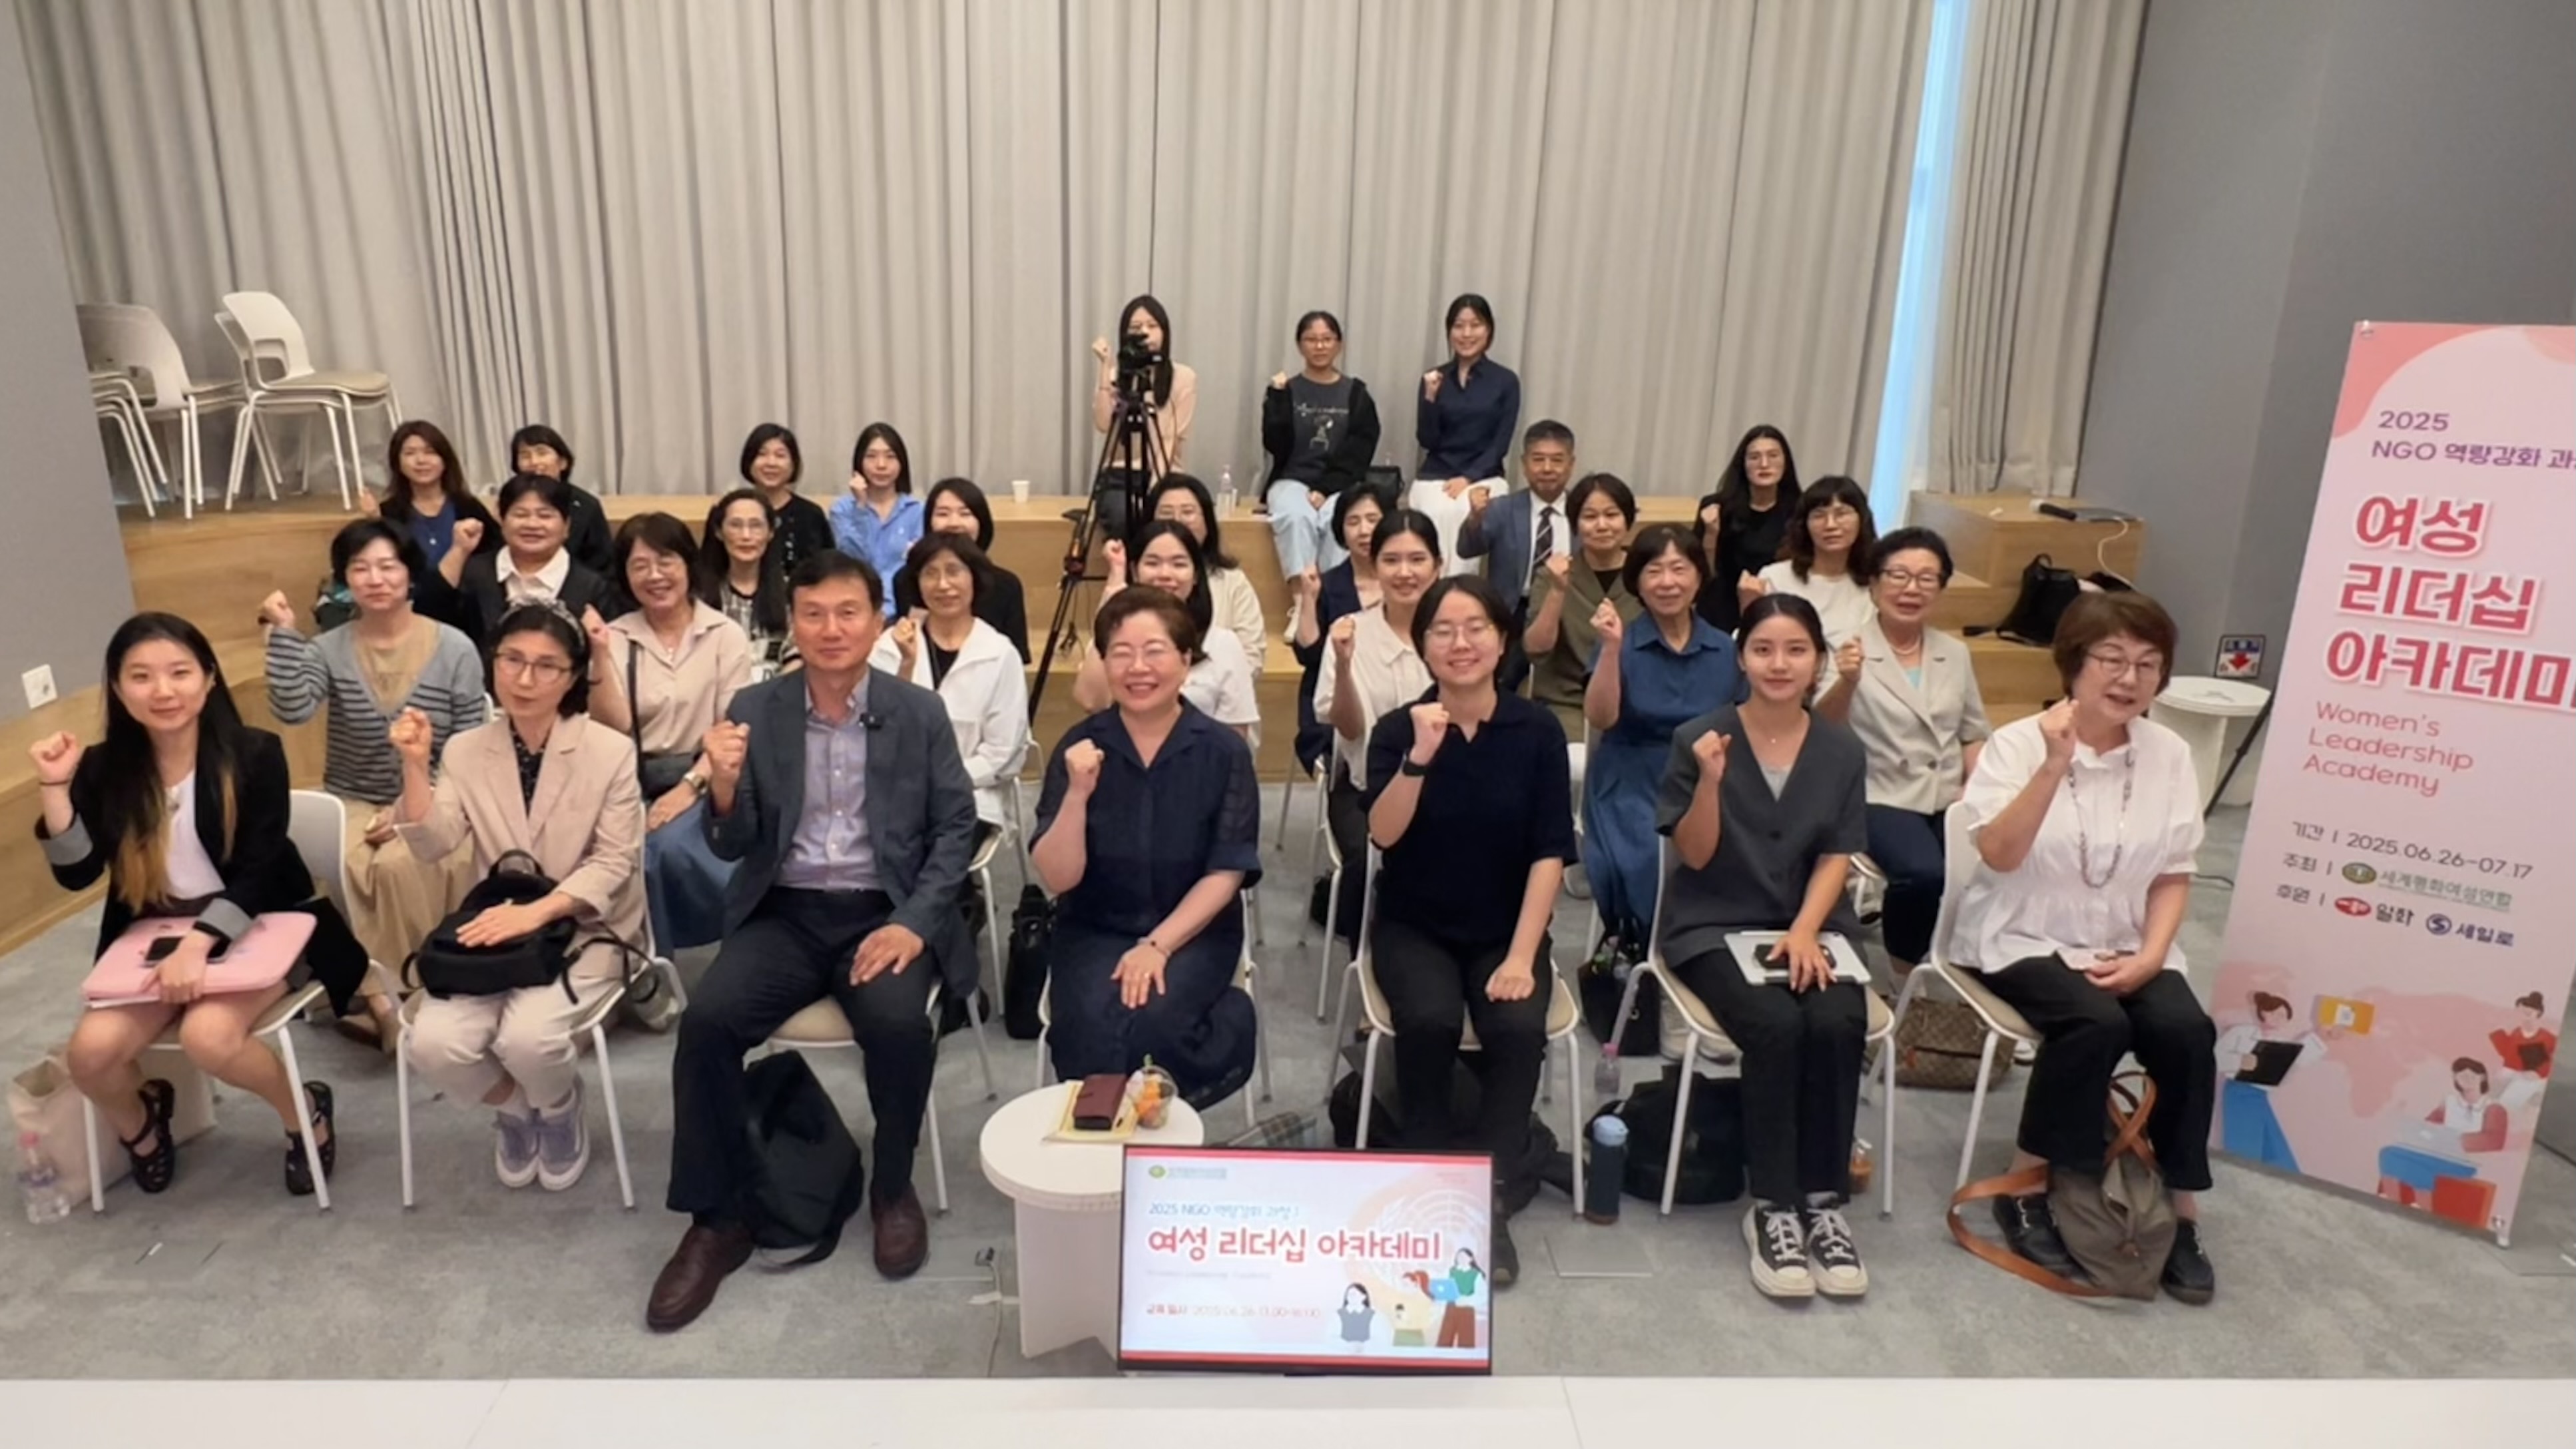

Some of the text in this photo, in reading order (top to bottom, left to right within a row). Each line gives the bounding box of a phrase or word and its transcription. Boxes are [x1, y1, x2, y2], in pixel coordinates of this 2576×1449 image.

[2378, 410, 2449, 432] 2025
[2372, 440, 2576, 469] NGO 역량강화 과
[2356, 496, 2484, 553] 여성
[2339, 563, 2535, 631] 리더십
[2316, 701, 2442, 737] Women's
[2308, 727, 2474, 772] Leadership
[2302, 753, 2440, 798] Academy
[2292, 821, 2324, 841] 기간
[2346, 832, 2533, 880] 2025.06.26-07.17
[2282, 852, 2317, 873] 주최
[2380, 869, 2512, 908] 세계평화여성연합
[2275, 884, 2311, 904] 후원
[2376, 903, 2415, 927] 일화
[2455, 923, 2515, 948] 세일로
[1149, 1202, 1178, 1215] 2025
[1180, 1203, 1211, 1216] NGO
[1147, 1226, 1441, 1263] 여성 리더십 아카데미
